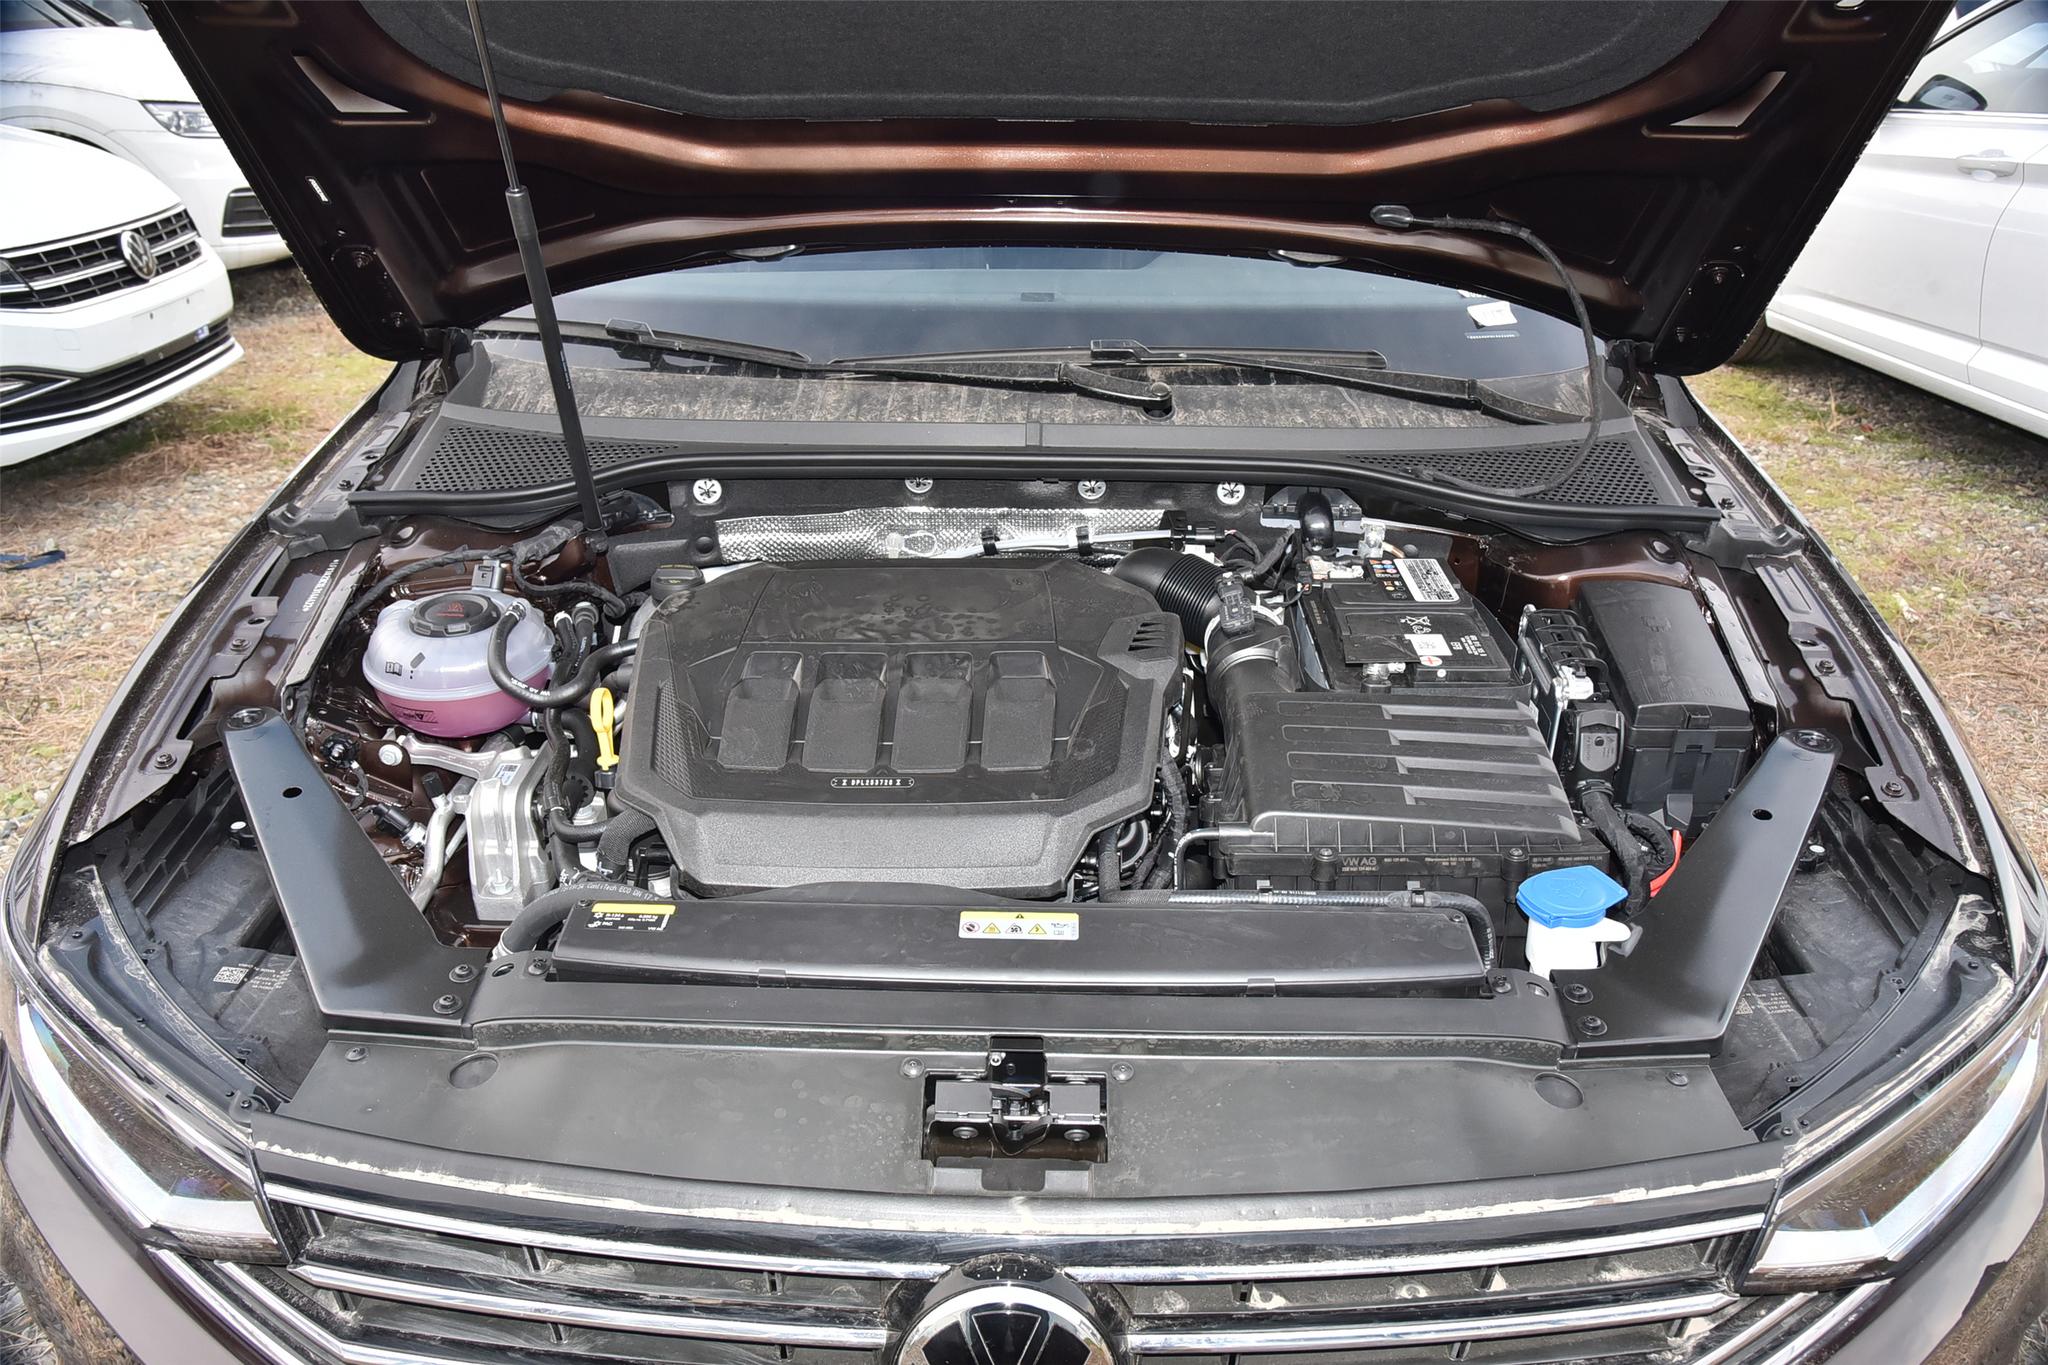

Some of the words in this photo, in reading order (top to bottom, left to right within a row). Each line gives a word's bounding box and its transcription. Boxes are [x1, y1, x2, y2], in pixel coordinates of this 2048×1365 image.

[1342, 857, 1360, 866] VW
[1360, 857, 1377, 866] AG
[619, 885, 632, 894] ECO
